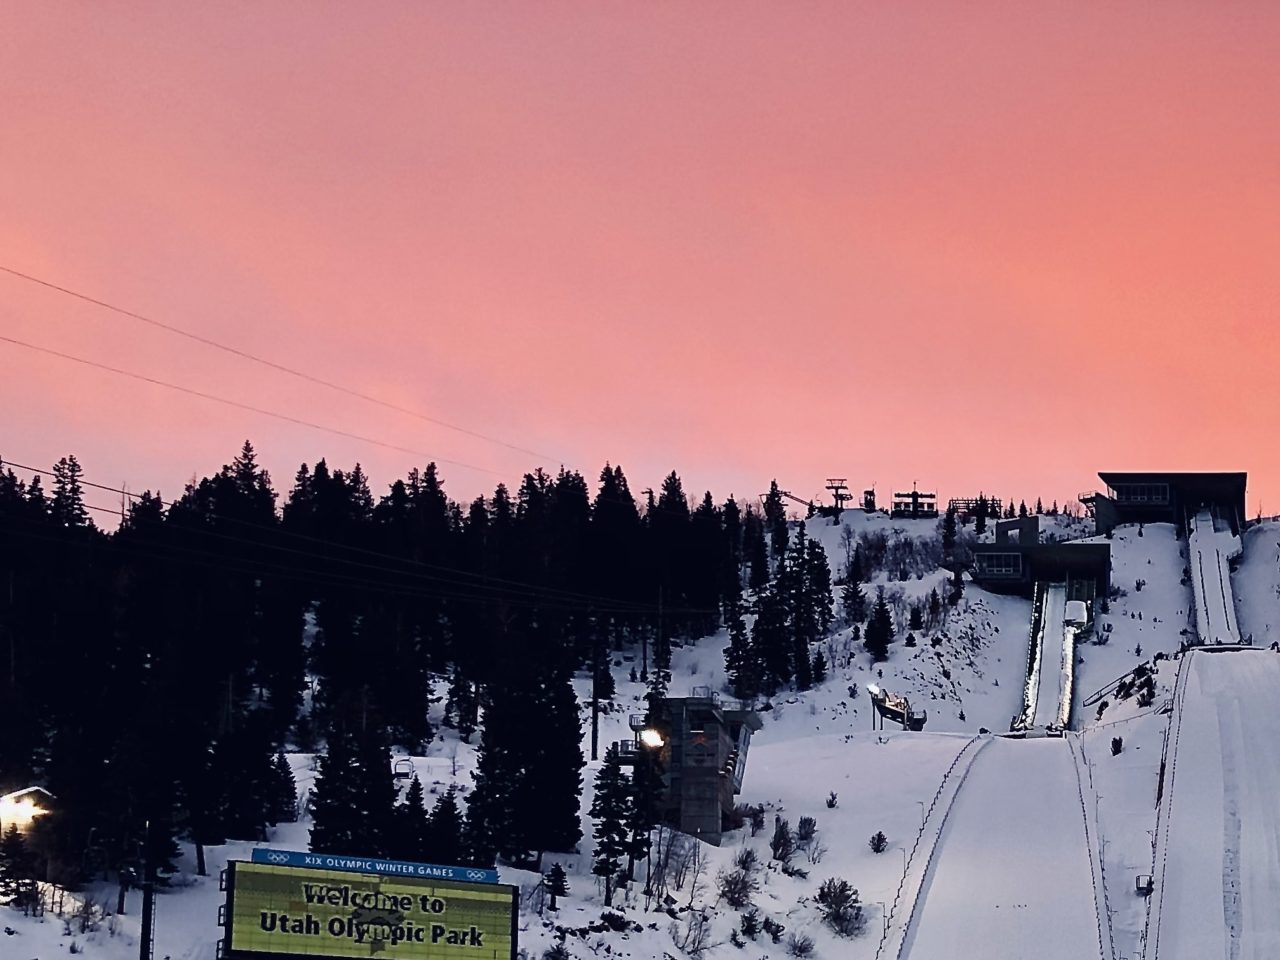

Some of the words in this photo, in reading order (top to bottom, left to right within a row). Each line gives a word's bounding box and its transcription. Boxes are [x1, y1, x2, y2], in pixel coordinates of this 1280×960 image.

[304, 856, 323, 865] XIX
[326, 858, 373, 870] OLYMPIC
[375, 862, 415, 874] WINTER
[417, 865, 454, 878] GAMES
[304, 883, 412, 911] Welcome
[420, 894, 445, 914] to
[260, 912, 320, 936] Utah
[328, 916, 425, 945] Olympic
[432, 925, 483, 947] Park
